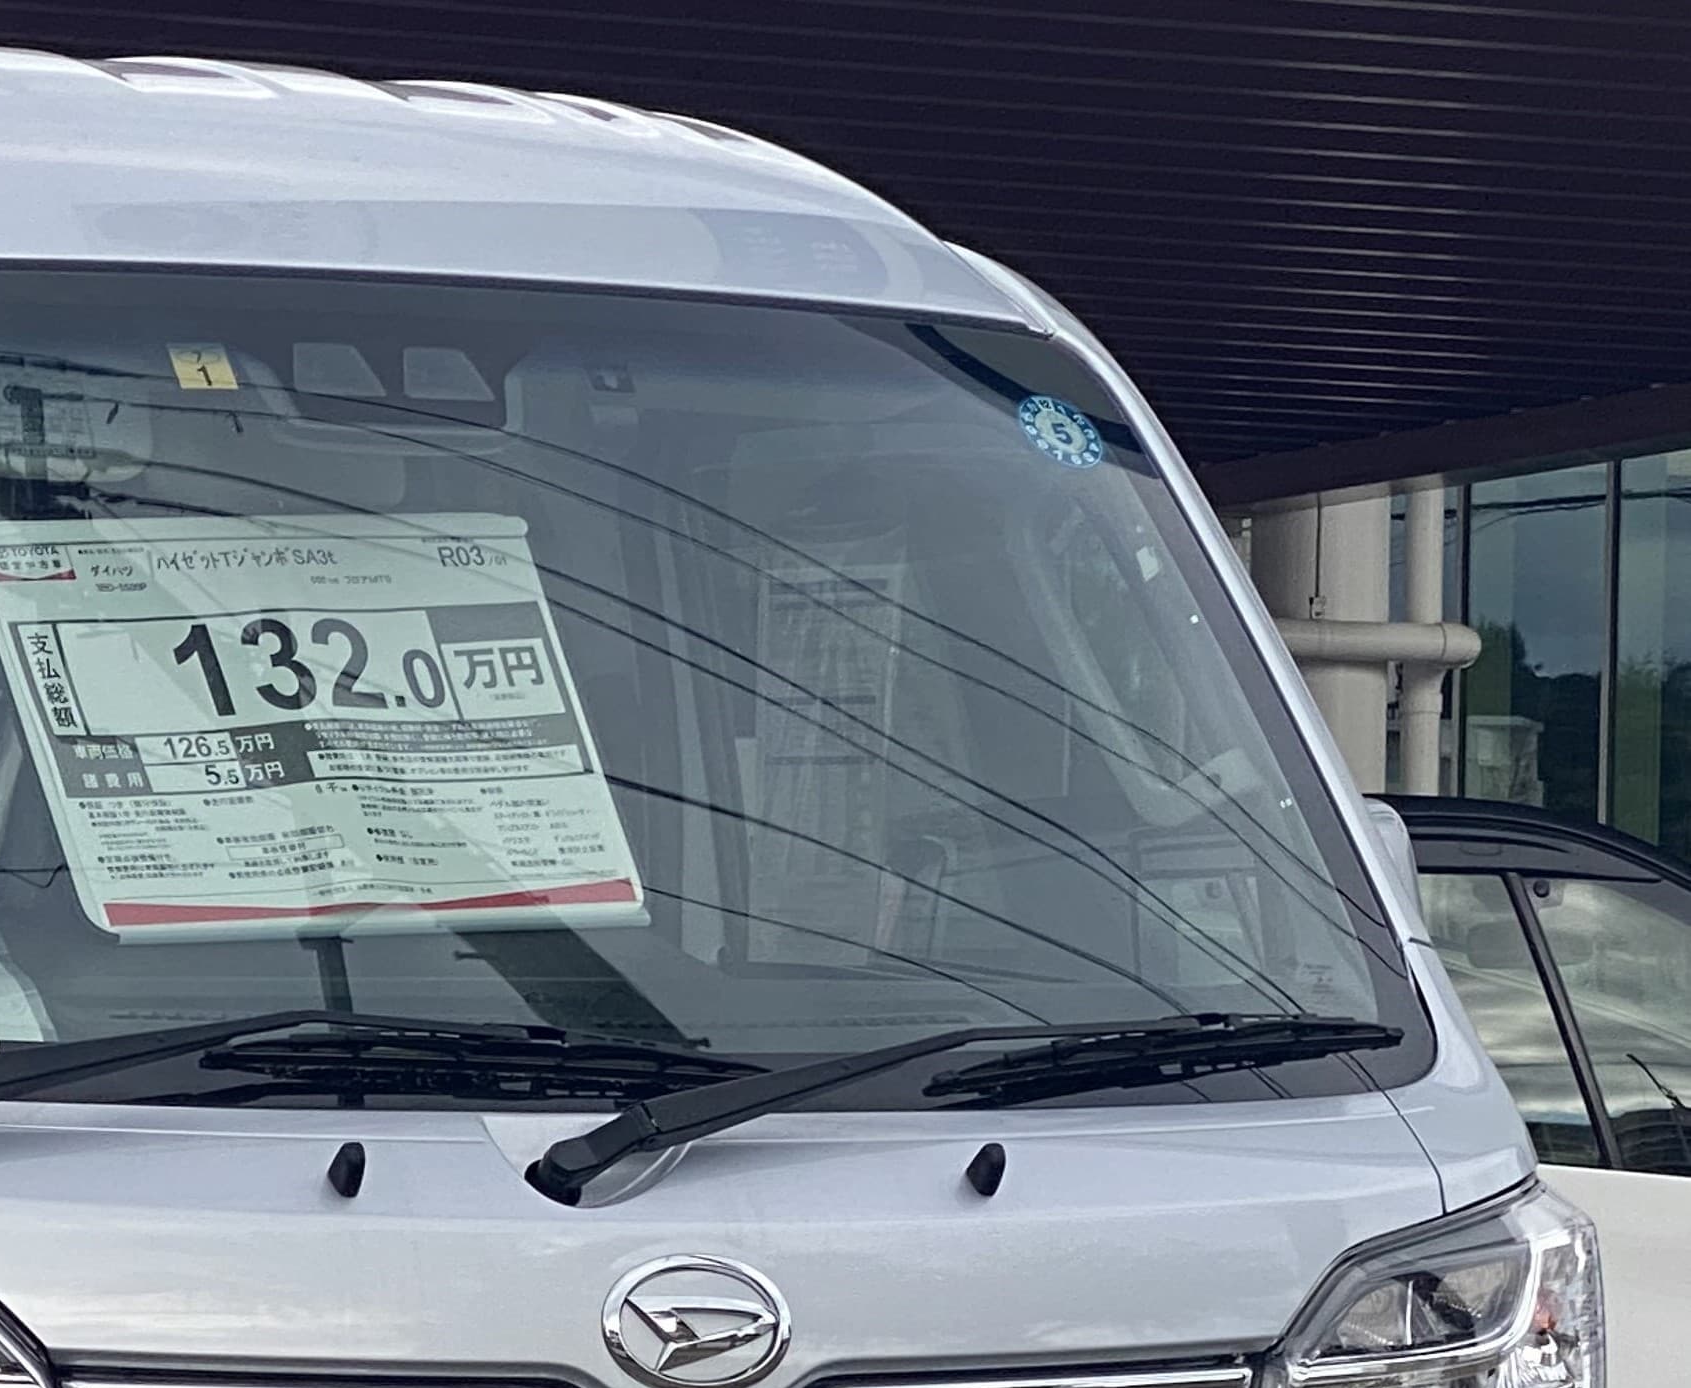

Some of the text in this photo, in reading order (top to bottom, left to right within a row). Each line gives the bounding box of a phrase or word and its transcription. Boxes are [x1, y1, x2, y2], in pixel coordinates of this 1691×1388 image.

[197, 364, 213, 387] 1
[1051, 422, 1073, 445] 5
[173, 617, 545, 717] 132.0 万円
[163, 735, 231, 760] 126.5
[235, 732, 275, 753] 万円
[204, 764, 240, 785] 5.5
[245, 761, 285, 782] 万円
